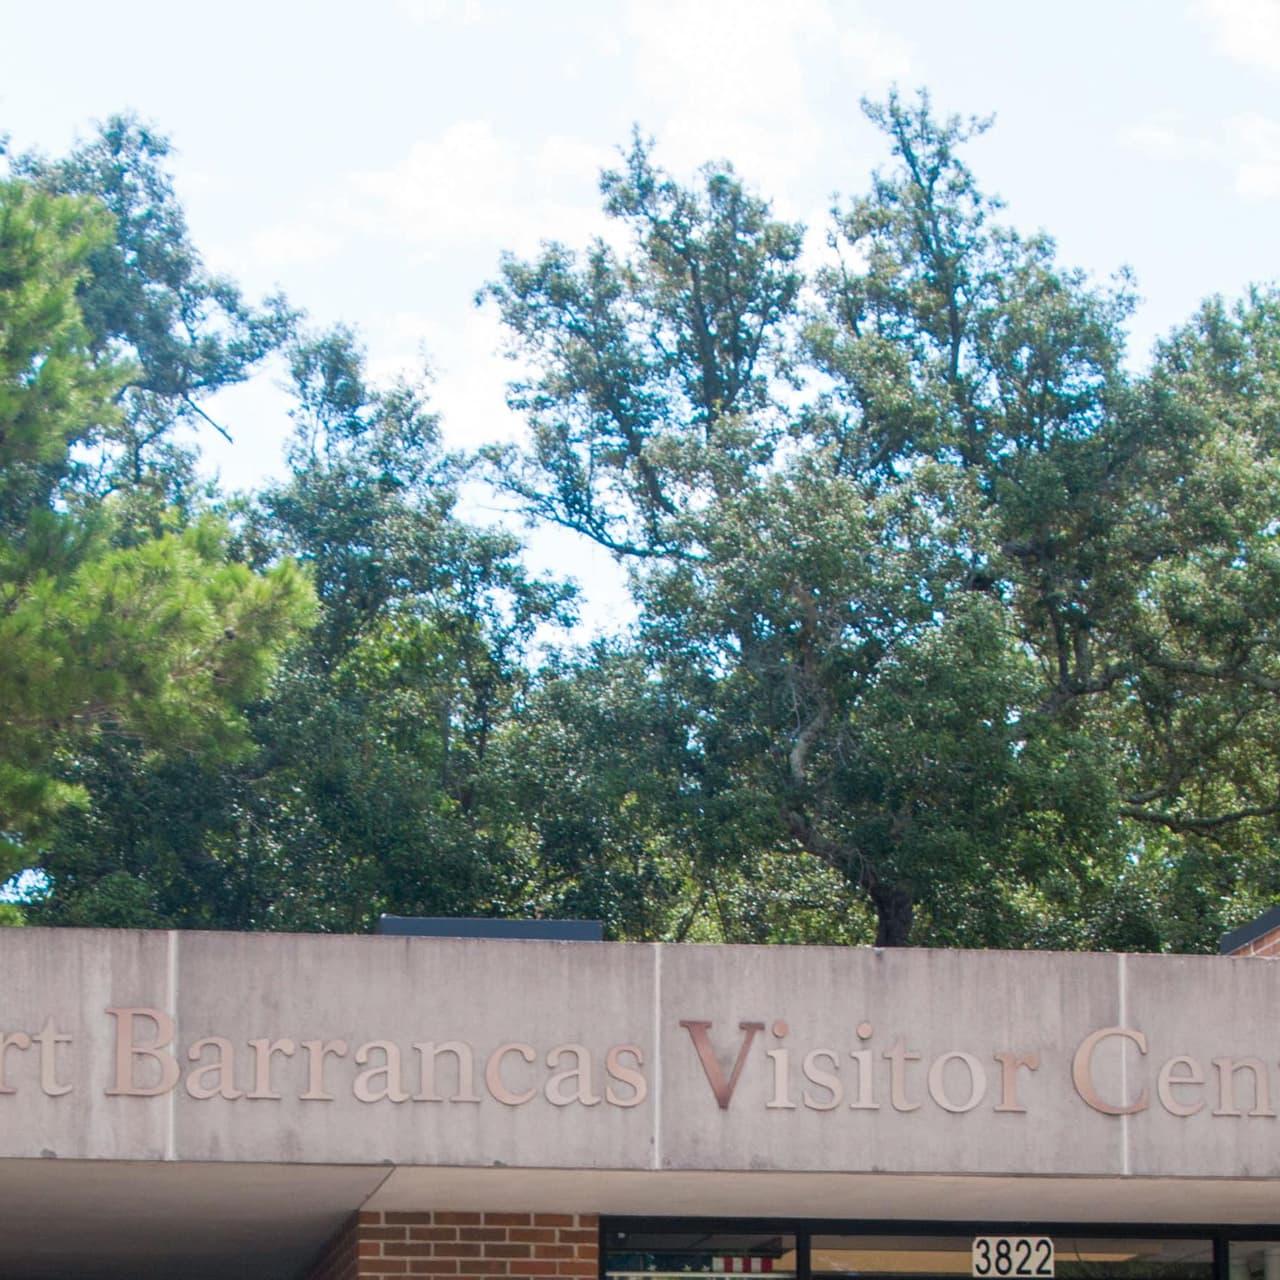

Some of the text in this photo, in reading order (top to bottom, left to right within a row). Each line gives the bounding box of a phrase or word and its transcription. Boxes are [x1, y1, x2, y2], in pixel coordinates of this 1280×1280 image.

[104, 1007, 649, 1109] Barrancas
[679, 1019, 1039, 1114] Visitor
[975, 1239, 1052, 1275] 3822
